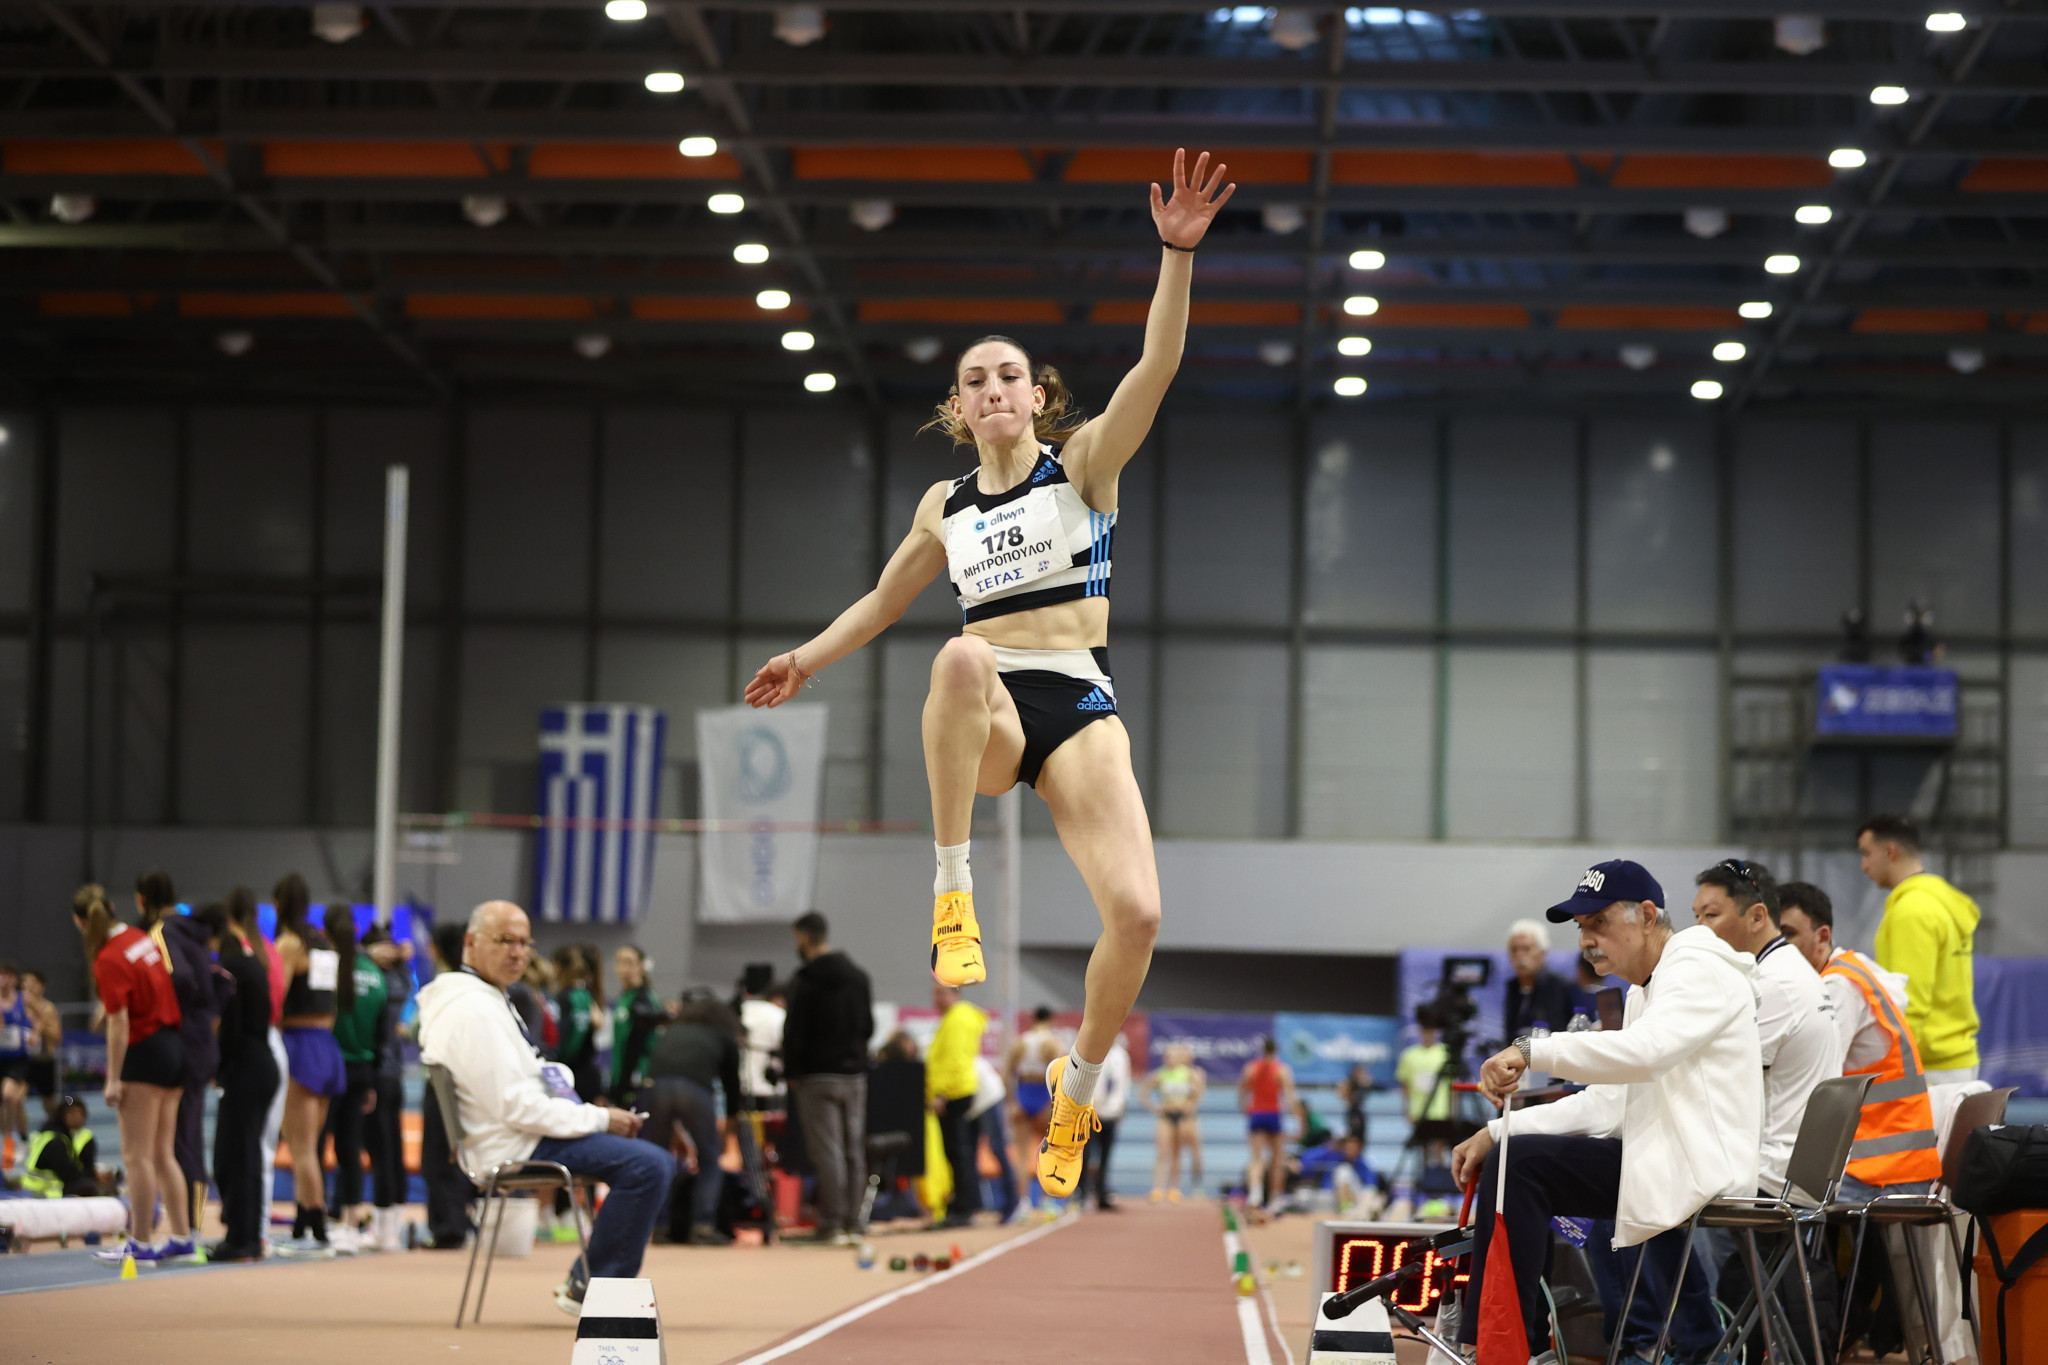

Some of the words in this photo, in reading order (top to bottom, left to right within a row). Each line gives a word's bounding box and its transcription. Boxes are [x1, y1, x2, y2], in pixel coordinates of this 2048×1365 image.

[1032, 467, 1058, 483] adidas
[990, 506, 1025, 526] allwyn
[980, 525, 1024, 555] 178
[963, 539, 1053, 579] ΜΗΤΡΟΠΟΥΛΟΥ
[976, 567, 1025, 593] ΣΕΓΑΣ
[1076, 701, 1114, 711] adidas
